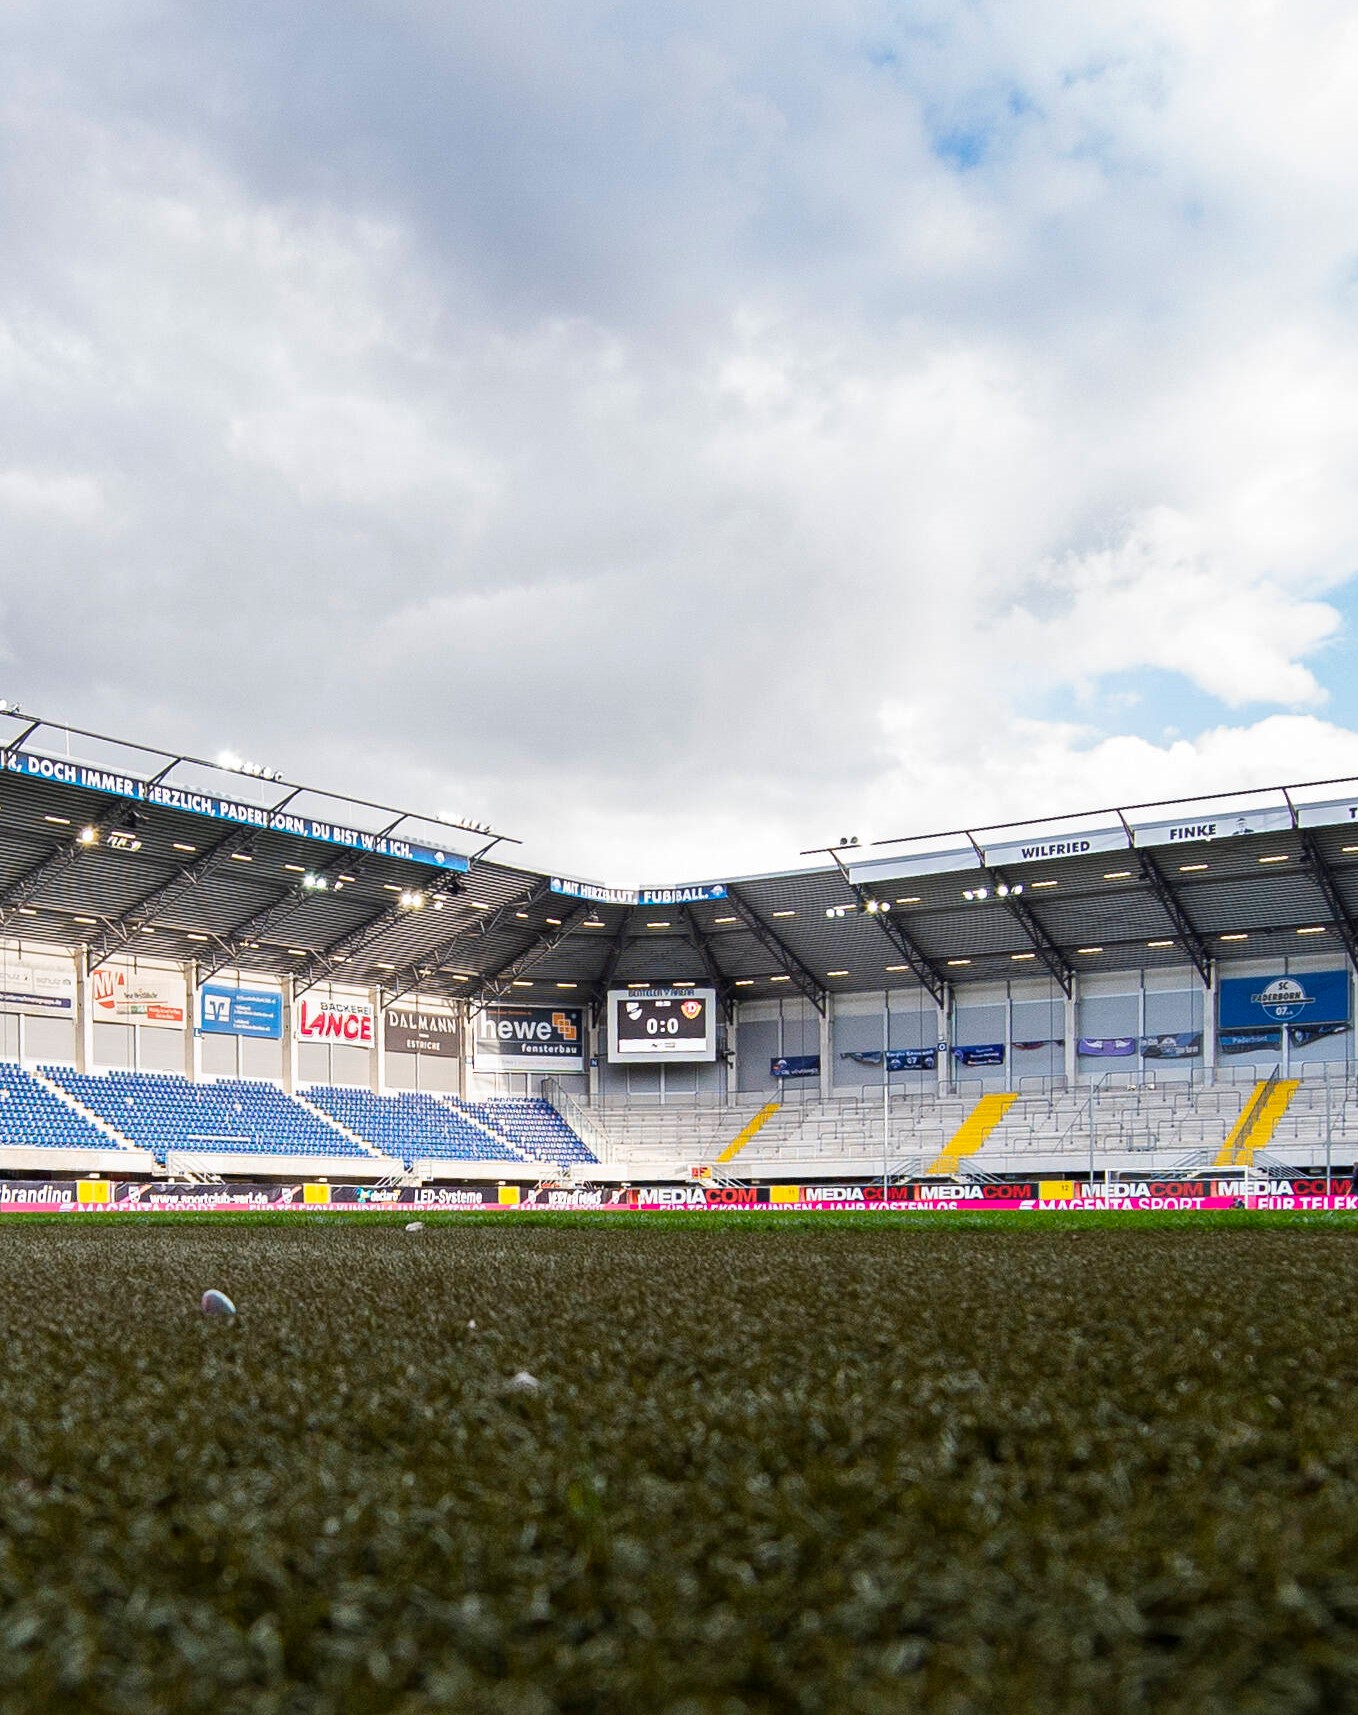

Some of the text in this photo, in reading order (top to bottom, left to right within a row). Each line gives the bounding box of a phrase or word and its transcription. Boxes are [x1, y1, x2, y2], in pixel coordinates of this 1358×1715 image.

[28, 756, 77, 783] DOCH
[81, 769, 134, 797] IMMER
[311, 821, 331, 840] DU
[333, 827, 359, 847] BIST
[1021, 840, 1090, 860] WILFRIED
[1169, 823, 1217, 841] FINKE
[1278, 981, 1289, 990] SC
[1251, 991, 1302, 1003] PADERBORN
[388, 1010, 457, 1034] DALMANN
[479, 1008, 553, 1041] hewe
[646, 1017, 679, 1035] 0:0
[194, 1028, 201, 1037] L
[406, 1039, 441, 1051] ESTRICHE
[521, 1043, 578, 1054] fensterbau
[0, 1183, 72, 1205] branding
[805, 1186, 907, 1201] MEDIACOM
[921, 1184, 1031, 1199] MEDIACOM
[1081, 1182, 1204, 1198] MEDIACOM
[1218, 1179, 1351, 1196] MEDIACOM
[413, 1188, 483, 1205] LED-Systeme
[639, 1188, 757, 1204] MEDIACOM
[1257, 1196, 1295, 1210] FÜR
